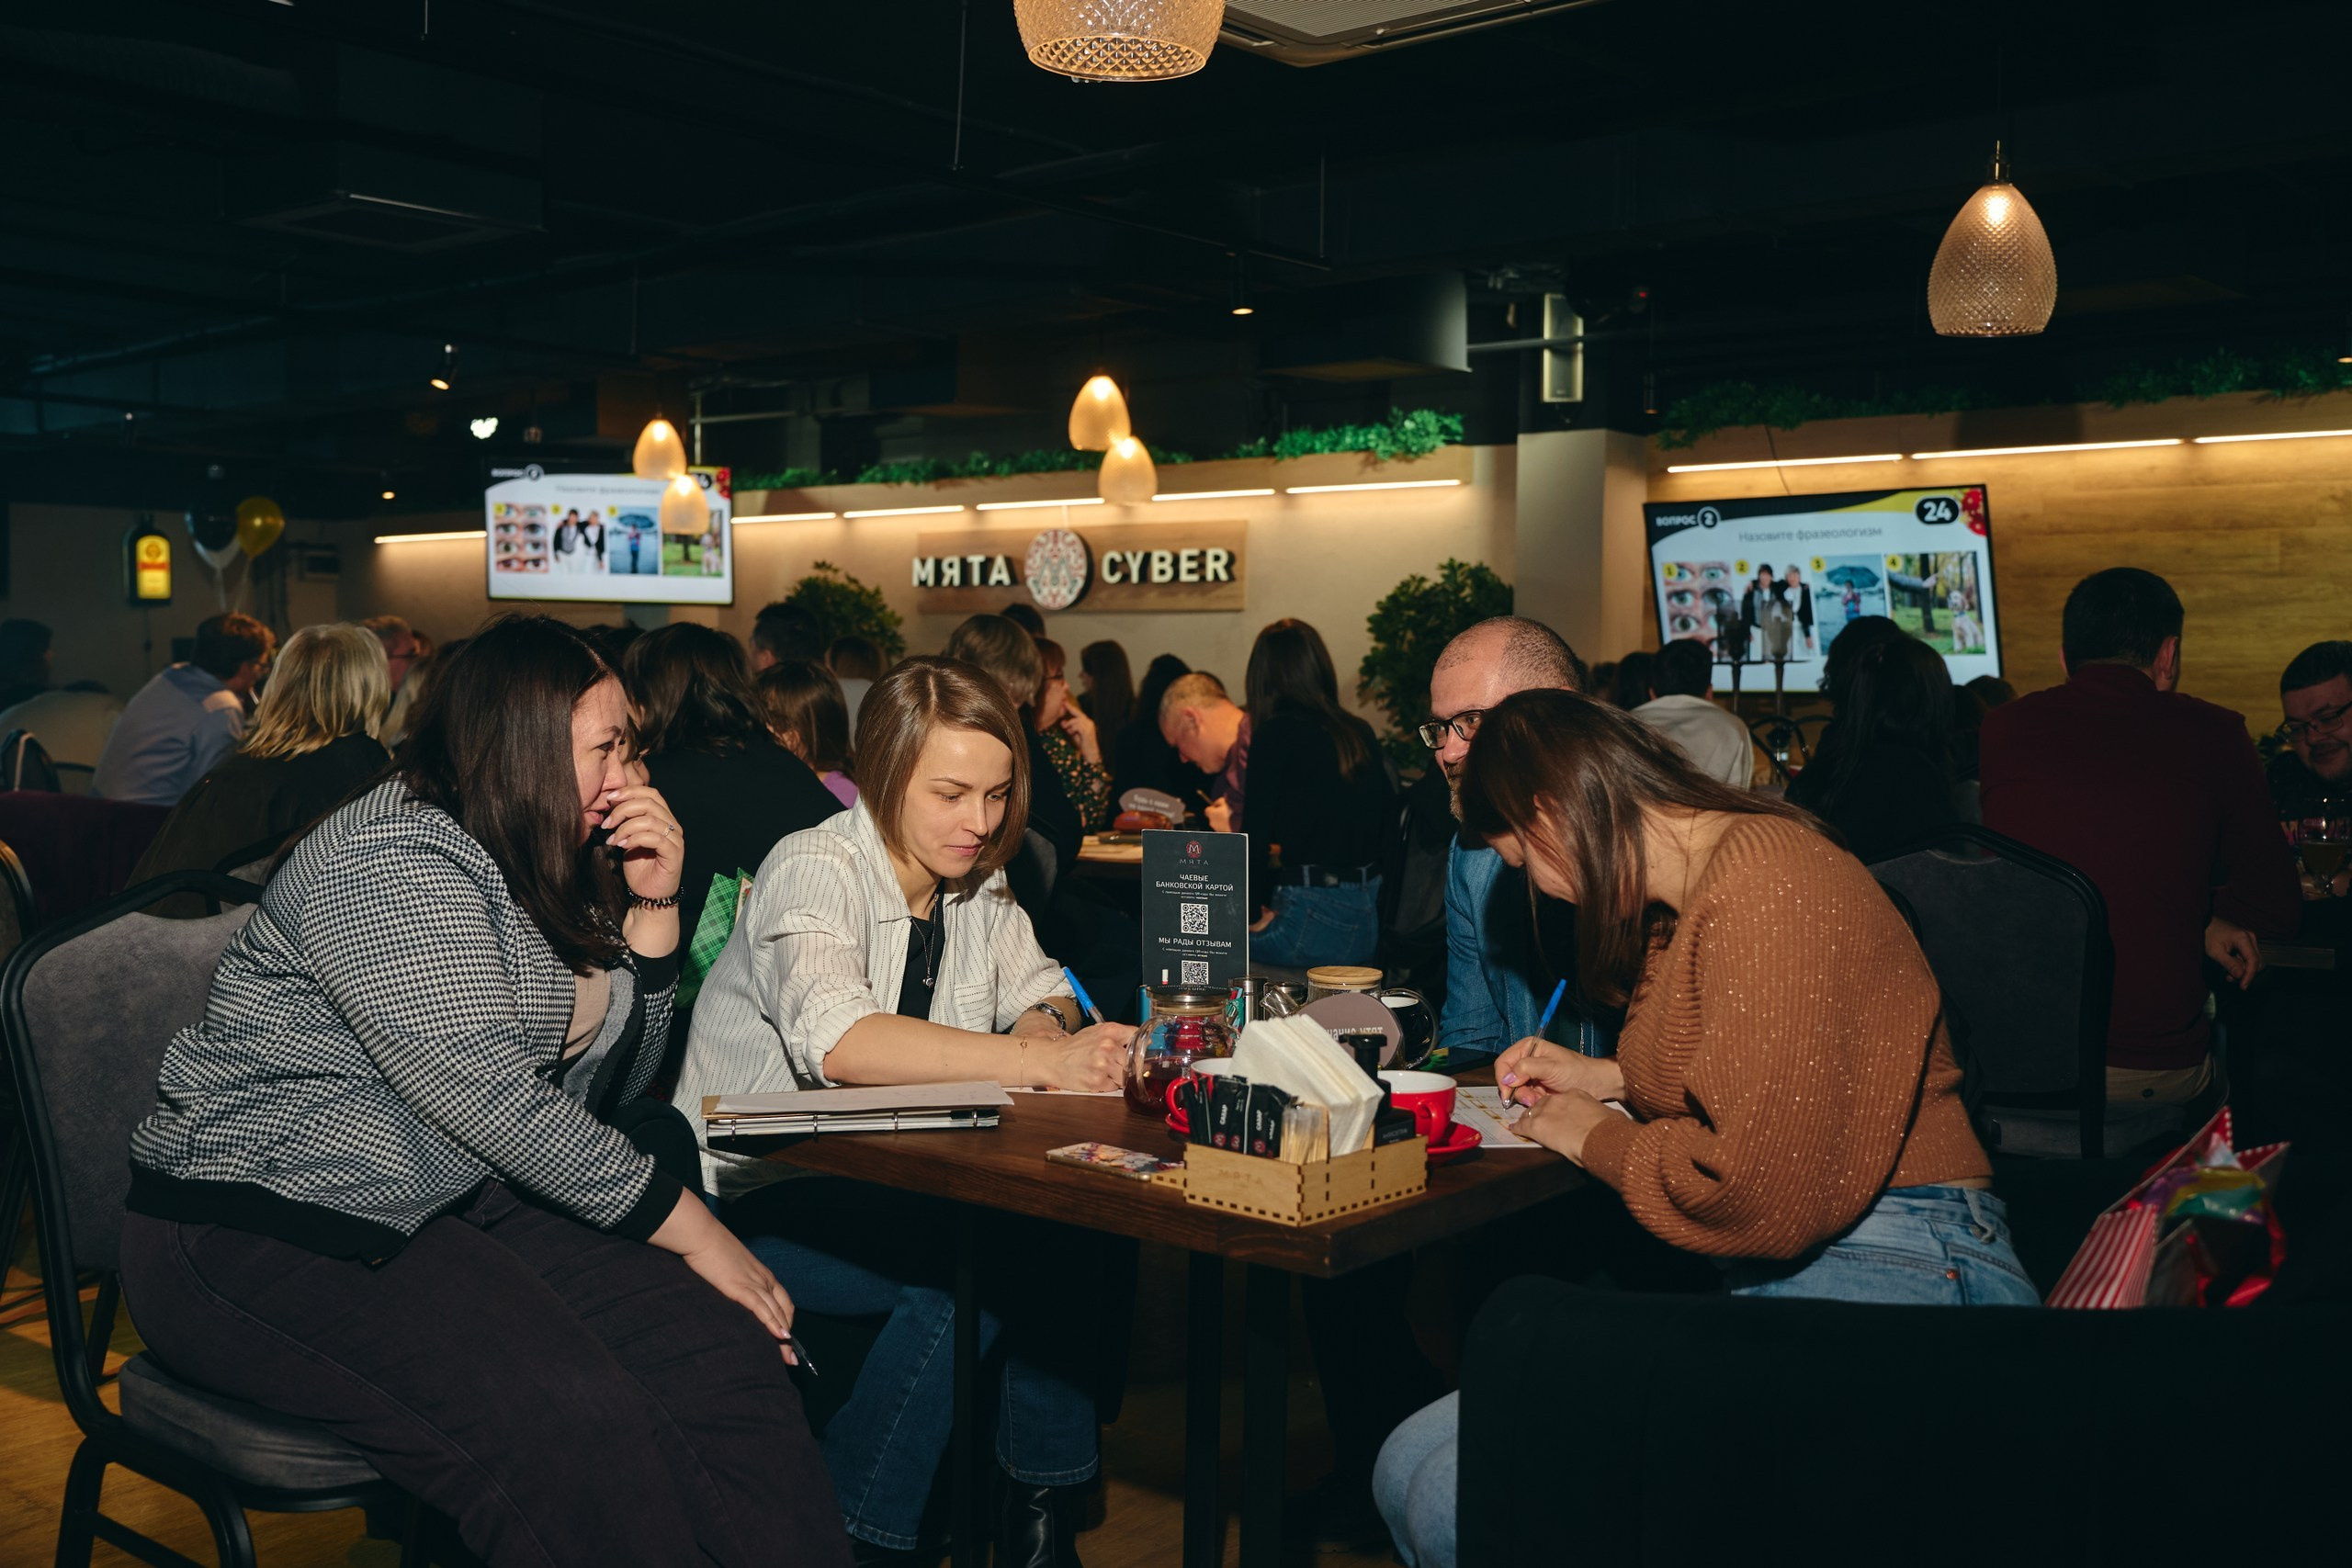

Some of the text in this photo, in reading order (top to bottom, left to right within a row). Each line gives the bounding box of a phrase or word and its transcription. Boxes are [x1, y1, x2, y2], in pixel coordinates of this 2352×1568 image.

[1923, 501, 1952, 522] 24
[1656, 512, 1714, 527] ВОПРОС 2
[1739, 527, 1883, 542] Назовите фразеологизм
[911, 547, 1230, 587] МЯТА CYBER
[1180, 874, 1209, 882] ЧАЕВЫЕ
[1156, 881, 1234, 892] БАНКОВСКОЙ КАРТОЙ
[1173, 938, 1194, 946] РАДЫ
[1196, 940, 1232, 948] ОТЗЫВАМ
